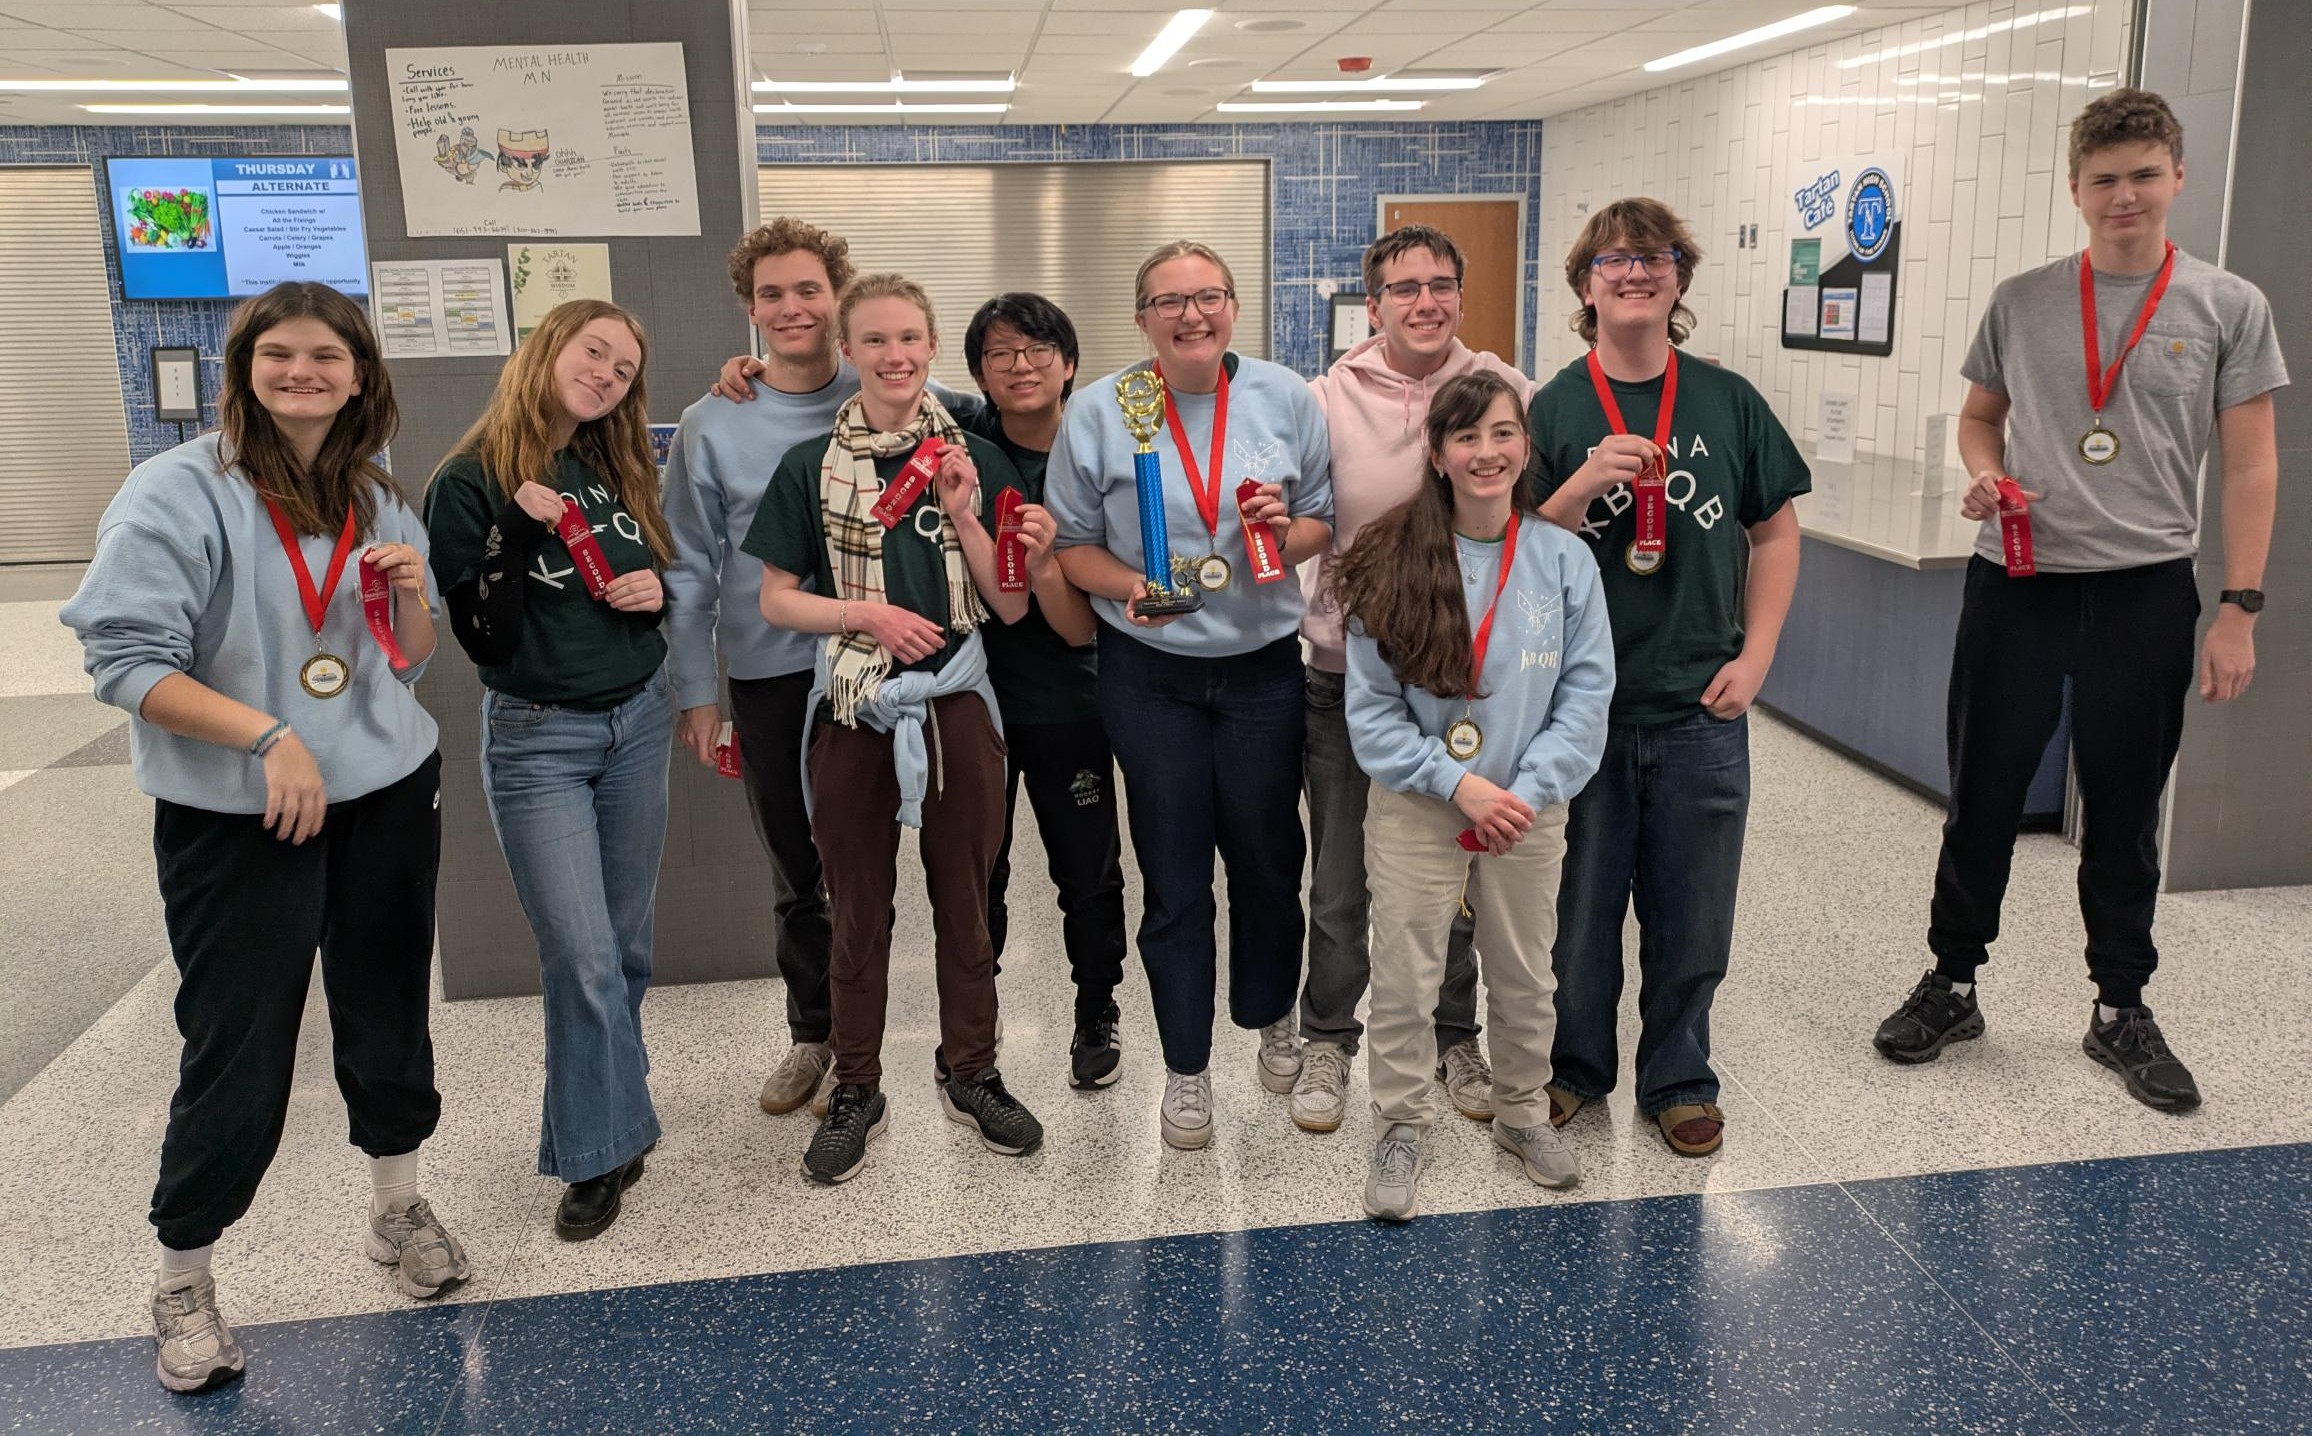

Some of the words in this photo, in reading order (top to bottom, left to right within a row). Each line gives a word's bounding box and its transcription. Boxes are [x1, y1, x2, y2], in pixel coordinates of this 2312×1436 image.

[493, 55, 542, 72] MENTAL
[548, 52, 589, 66] HEALTH
[407, 64, 455, 79] Services
[235, 163, 315, 175] THURSDAY
[252, 182, 330, 191] ALTERNATE
[1795, 170, 1839, 212] Tartan
[1804, 195, 1834, 230] Café
[542, 249, 578, 264] TARTAN
[1255, 532, 1270, 572] SECOND
[582, 549, 605, 589] SECOND
[1007, 540, 1015, 582] SECOND
[1258, 569, 1280, 578] PLACE
[1077, 795, 1099, 806] LIAO
